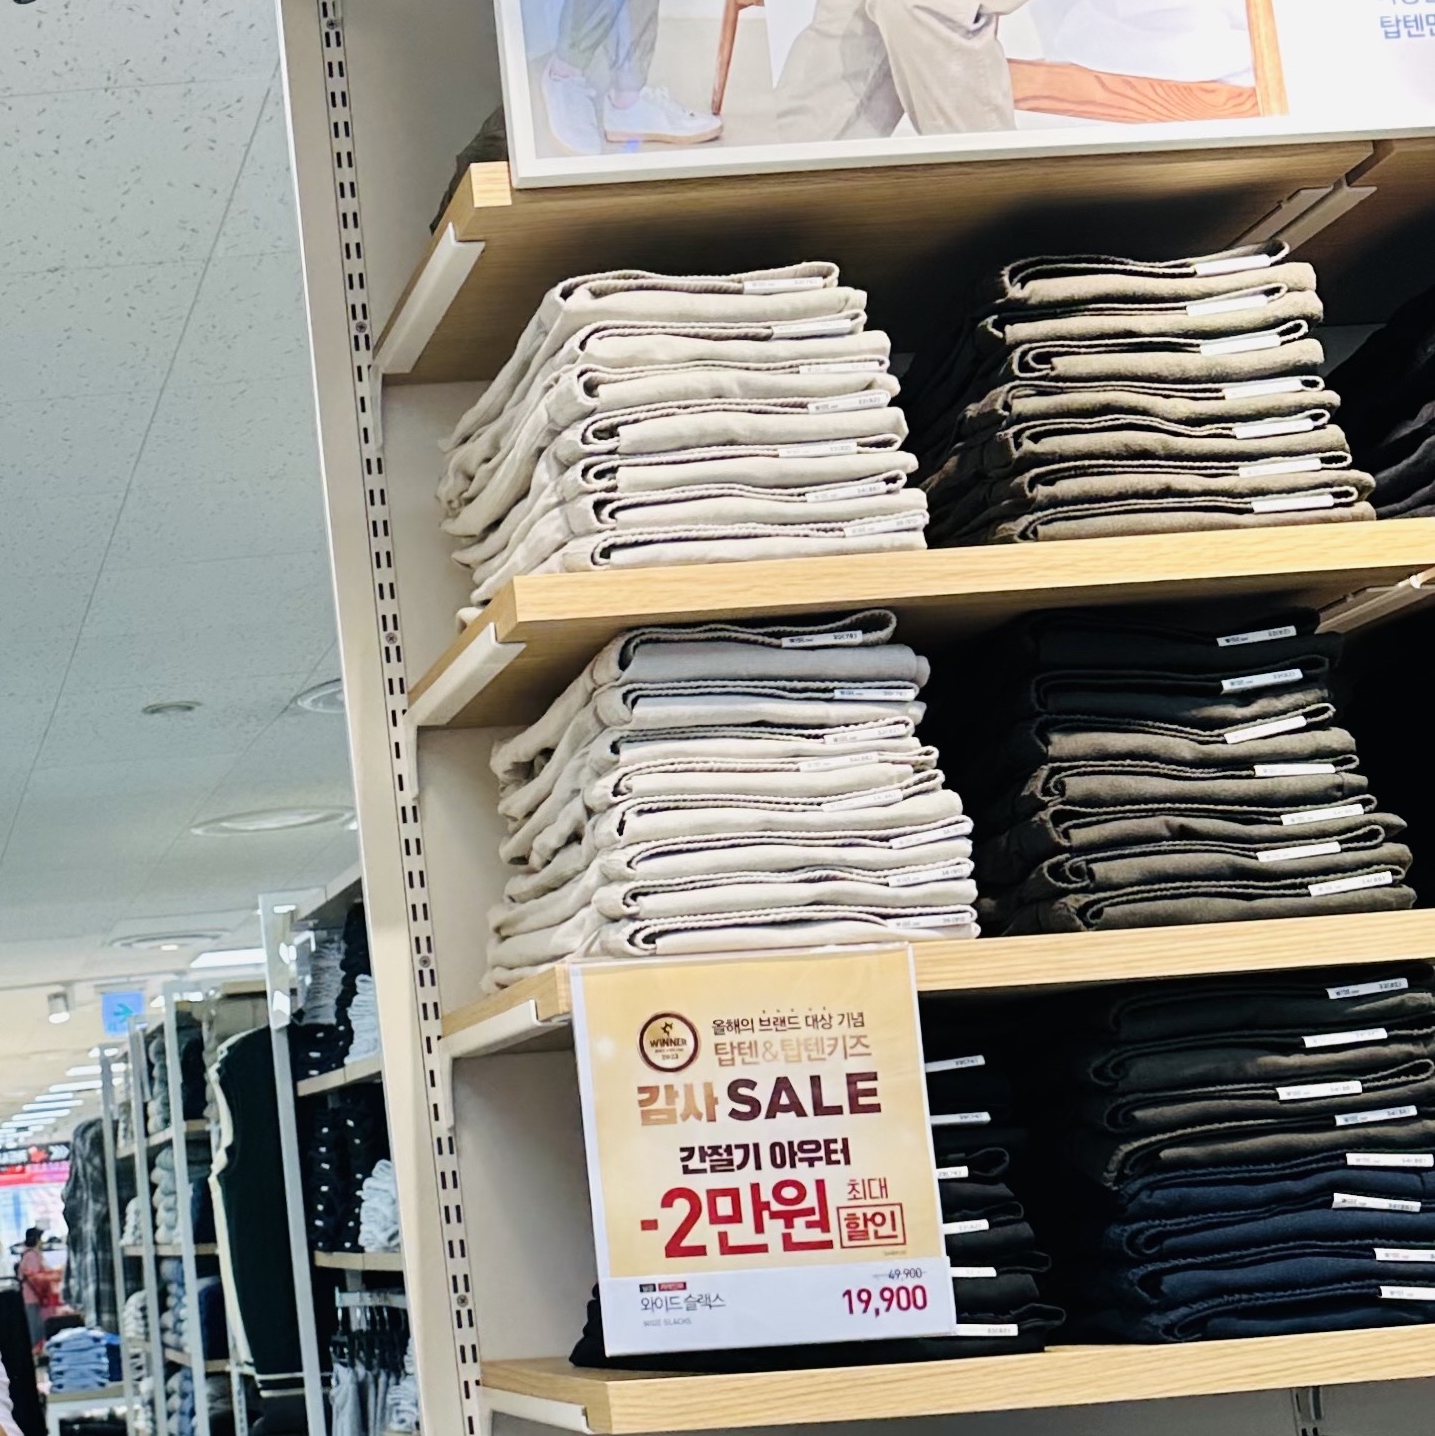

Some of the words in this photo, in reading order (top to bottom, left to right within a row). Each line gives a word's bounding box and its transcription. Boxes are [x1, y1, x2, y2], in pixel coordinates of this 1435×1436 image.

[712, 1018, 755, 1035] 올해의
[759, 1015, 802, 1032] 브랜드
[805, 1013, 833, 1030] 대상
[838, 1012, 865, 1028] 기념
[727, 1072, 882, 1121] SALE
[679, 1143, 762, 1174] 간절기
[769, 1138, 851, 1169] 아우터
[847, 1177, 889, 1201] 최대
[844, 1210, 898, 1242] 할인
[842, 1284, 928, 1318] 19,900
